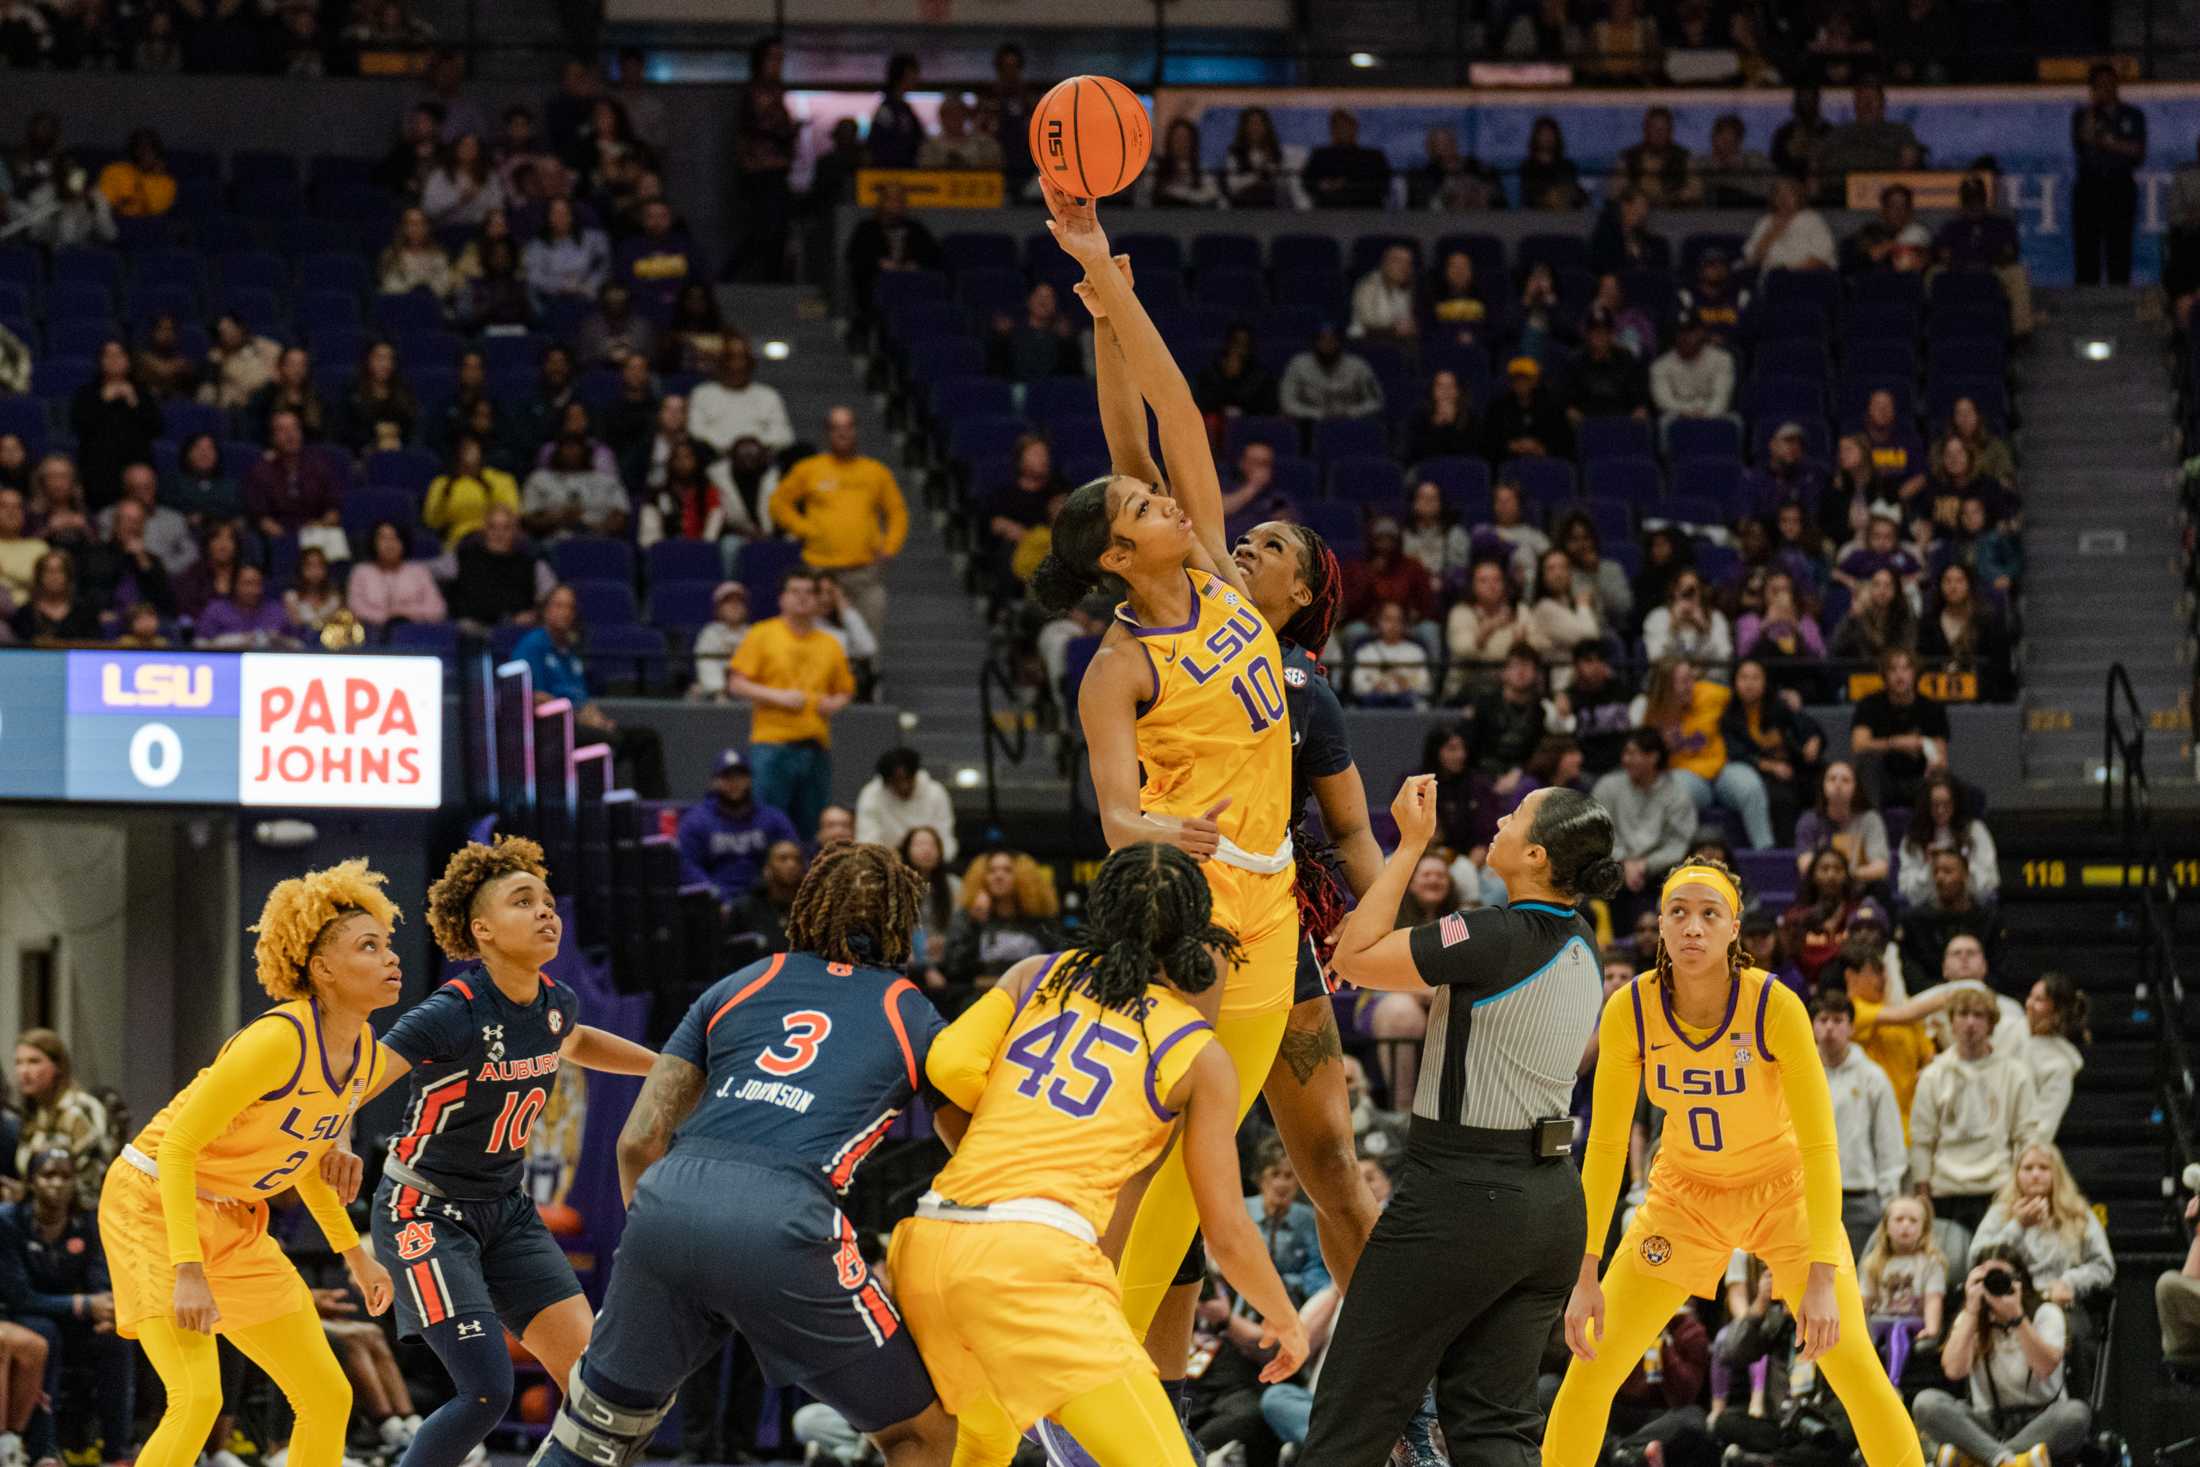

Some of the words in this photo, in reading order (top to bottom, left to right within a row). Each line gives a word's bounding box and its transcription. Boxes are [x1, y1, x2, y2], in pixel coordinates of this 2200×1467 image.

[1048, 120, 1069, 171] LSU
[1179, 606, 1263, 686] LSU
[101, 662, 214, 708] LSU
[259, 678, 417, 736] PAPA
[1230, 654, 1285, 734] 10
[128, 722, 183, 788] 0
[254, 745, 420, 785] JOHNS
[2173, 858, 2200, 888] 11
[477, 1052, 560, 1081] AUBURN
[755, 1010, 832, 1076] 3
[1005, 1009, 1139, 1119] 45
[716, 1076, 735, 1098] J.
[734, 1079, 816, 1115] JOHNSON
[1656, 1064, 1746, 1096] LSU
[279, 1106, 350, 1141] LSU
[486, 1087, 546, 1153] 10
[1688, 1106, 1723, 1153] 0
[254, 1150, 309, 1191] 2
